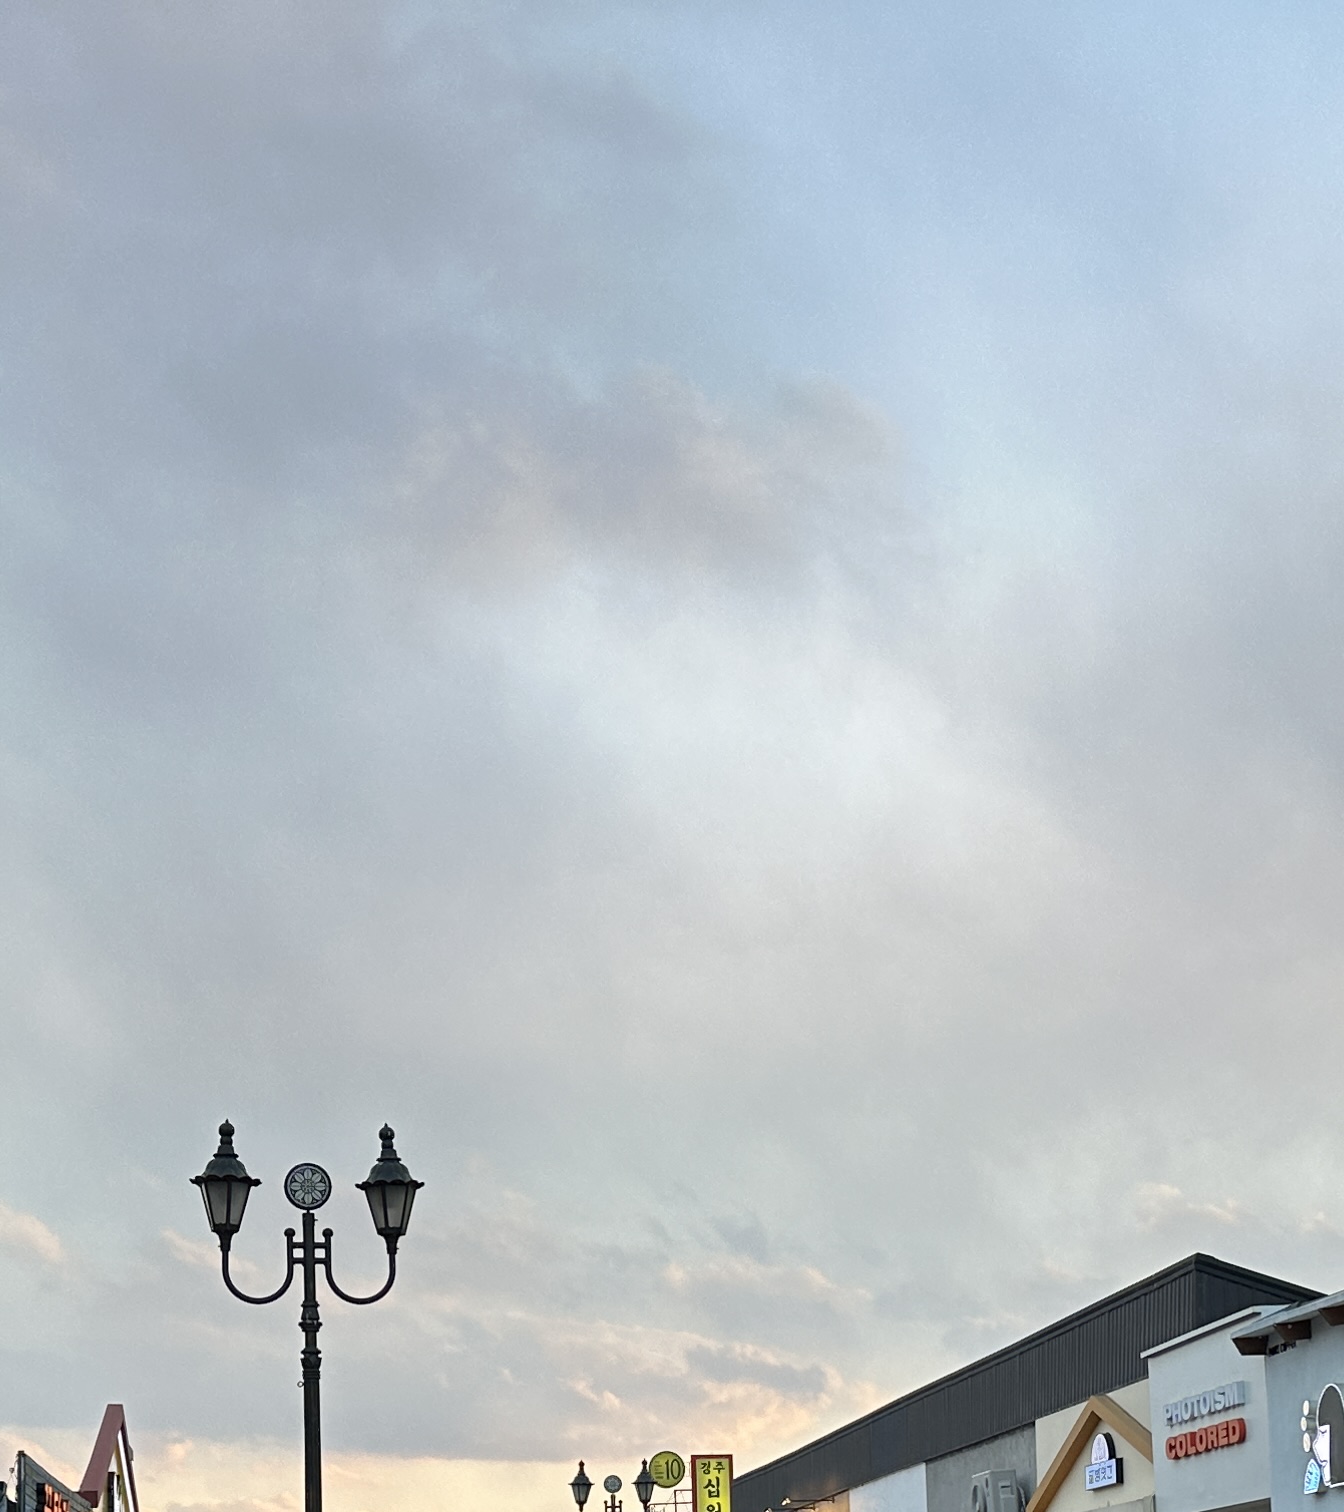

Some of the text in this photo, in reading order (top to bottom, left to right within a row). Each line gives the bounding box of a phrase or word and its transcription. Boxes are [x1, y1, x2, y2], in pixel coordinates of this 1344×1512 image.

[1163, 1380, 1248, 1428] PHOTOISM
[1165, 1417, 1247, 1461] COLORED
[701, 1462, 725, 1475] 경주
